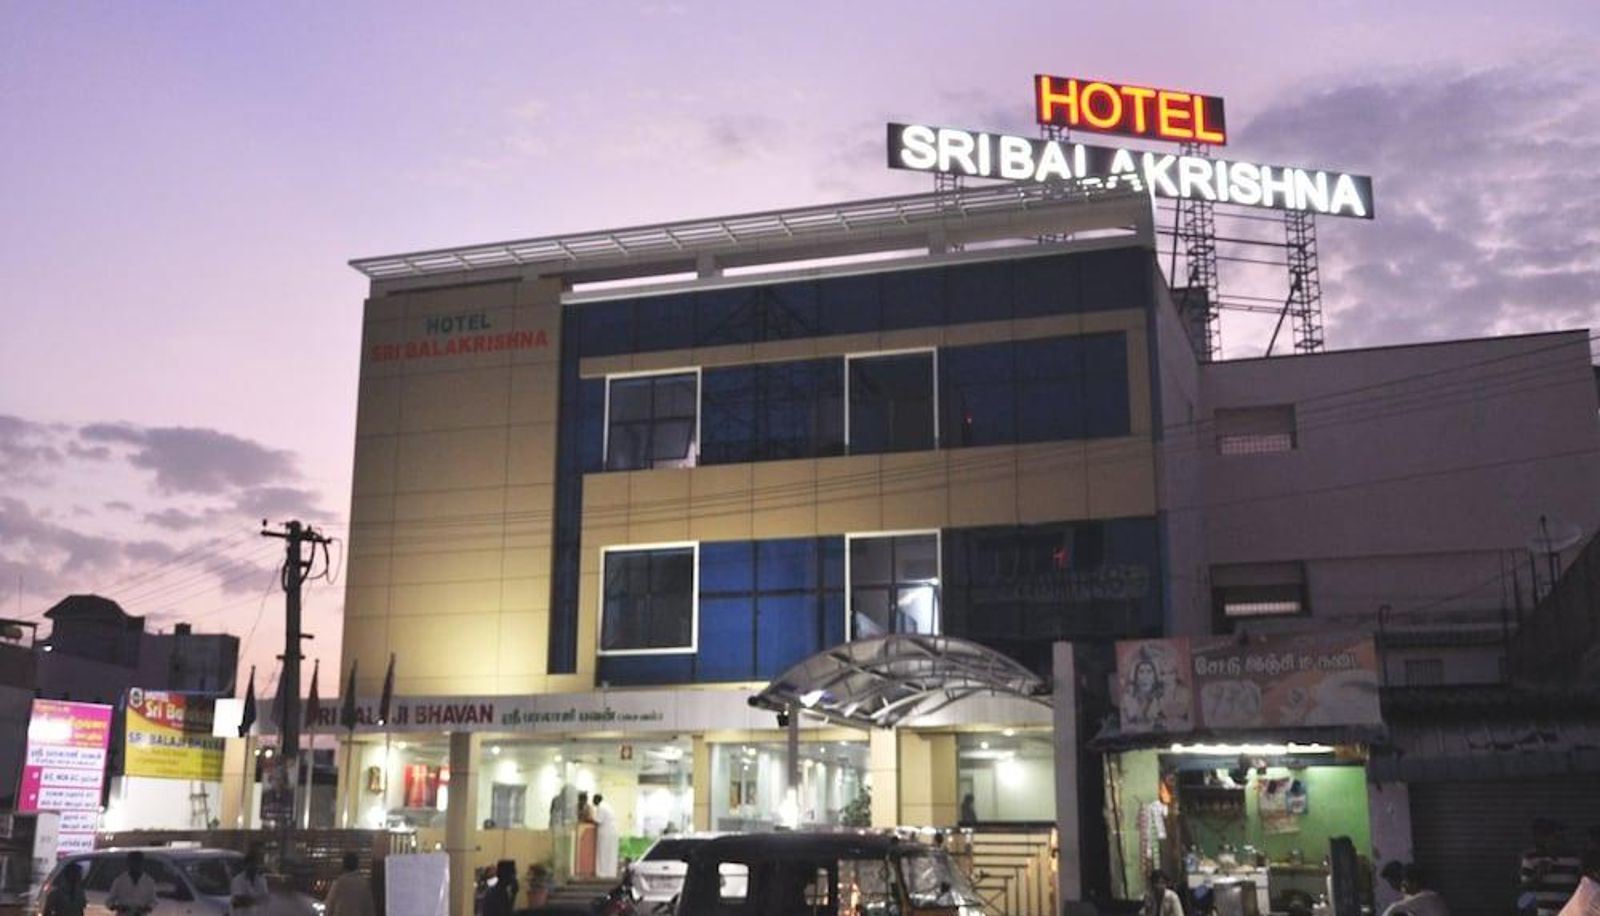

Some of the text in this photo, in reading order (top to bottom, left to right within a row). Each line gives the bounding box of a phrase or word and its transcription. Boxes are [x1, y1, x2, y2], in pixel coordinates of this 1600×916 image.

[1041, 77, 1225, 142] HOTEL
[900, 125, 990, 176] SRI
[426, 313, 492, 335] HOTEL
[371, 329, 549, 363] SRI BALAKRISHNA
[415, 703, 493, 725] BHAVAN
